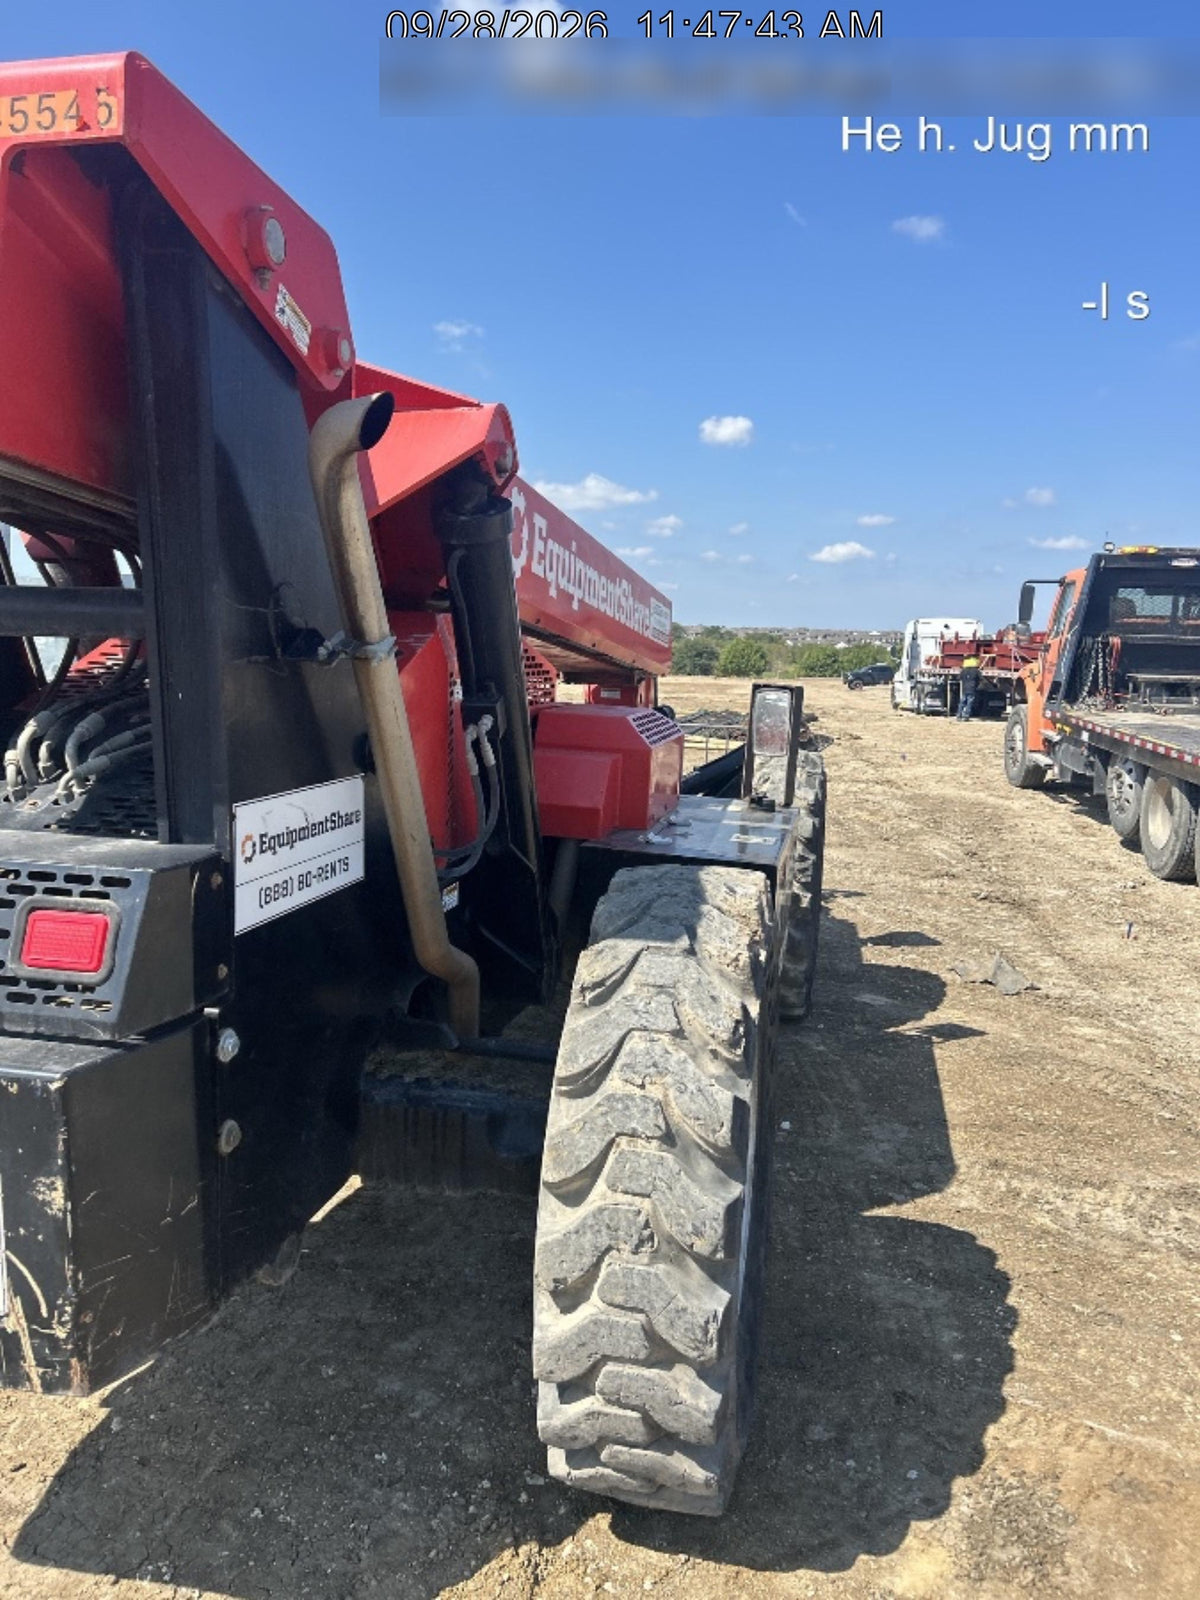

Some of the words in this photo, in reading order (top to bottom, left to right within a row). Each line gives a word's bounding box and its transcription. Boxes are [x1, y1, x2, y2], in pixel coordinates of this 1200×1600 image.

[531, 512, 651, 637] EquipmentShare
[258, 810, 362, 855] EquipmentShare
[258, 876, 294, 909] (888)
[297, 856, 350, 891] 80-RENTS
